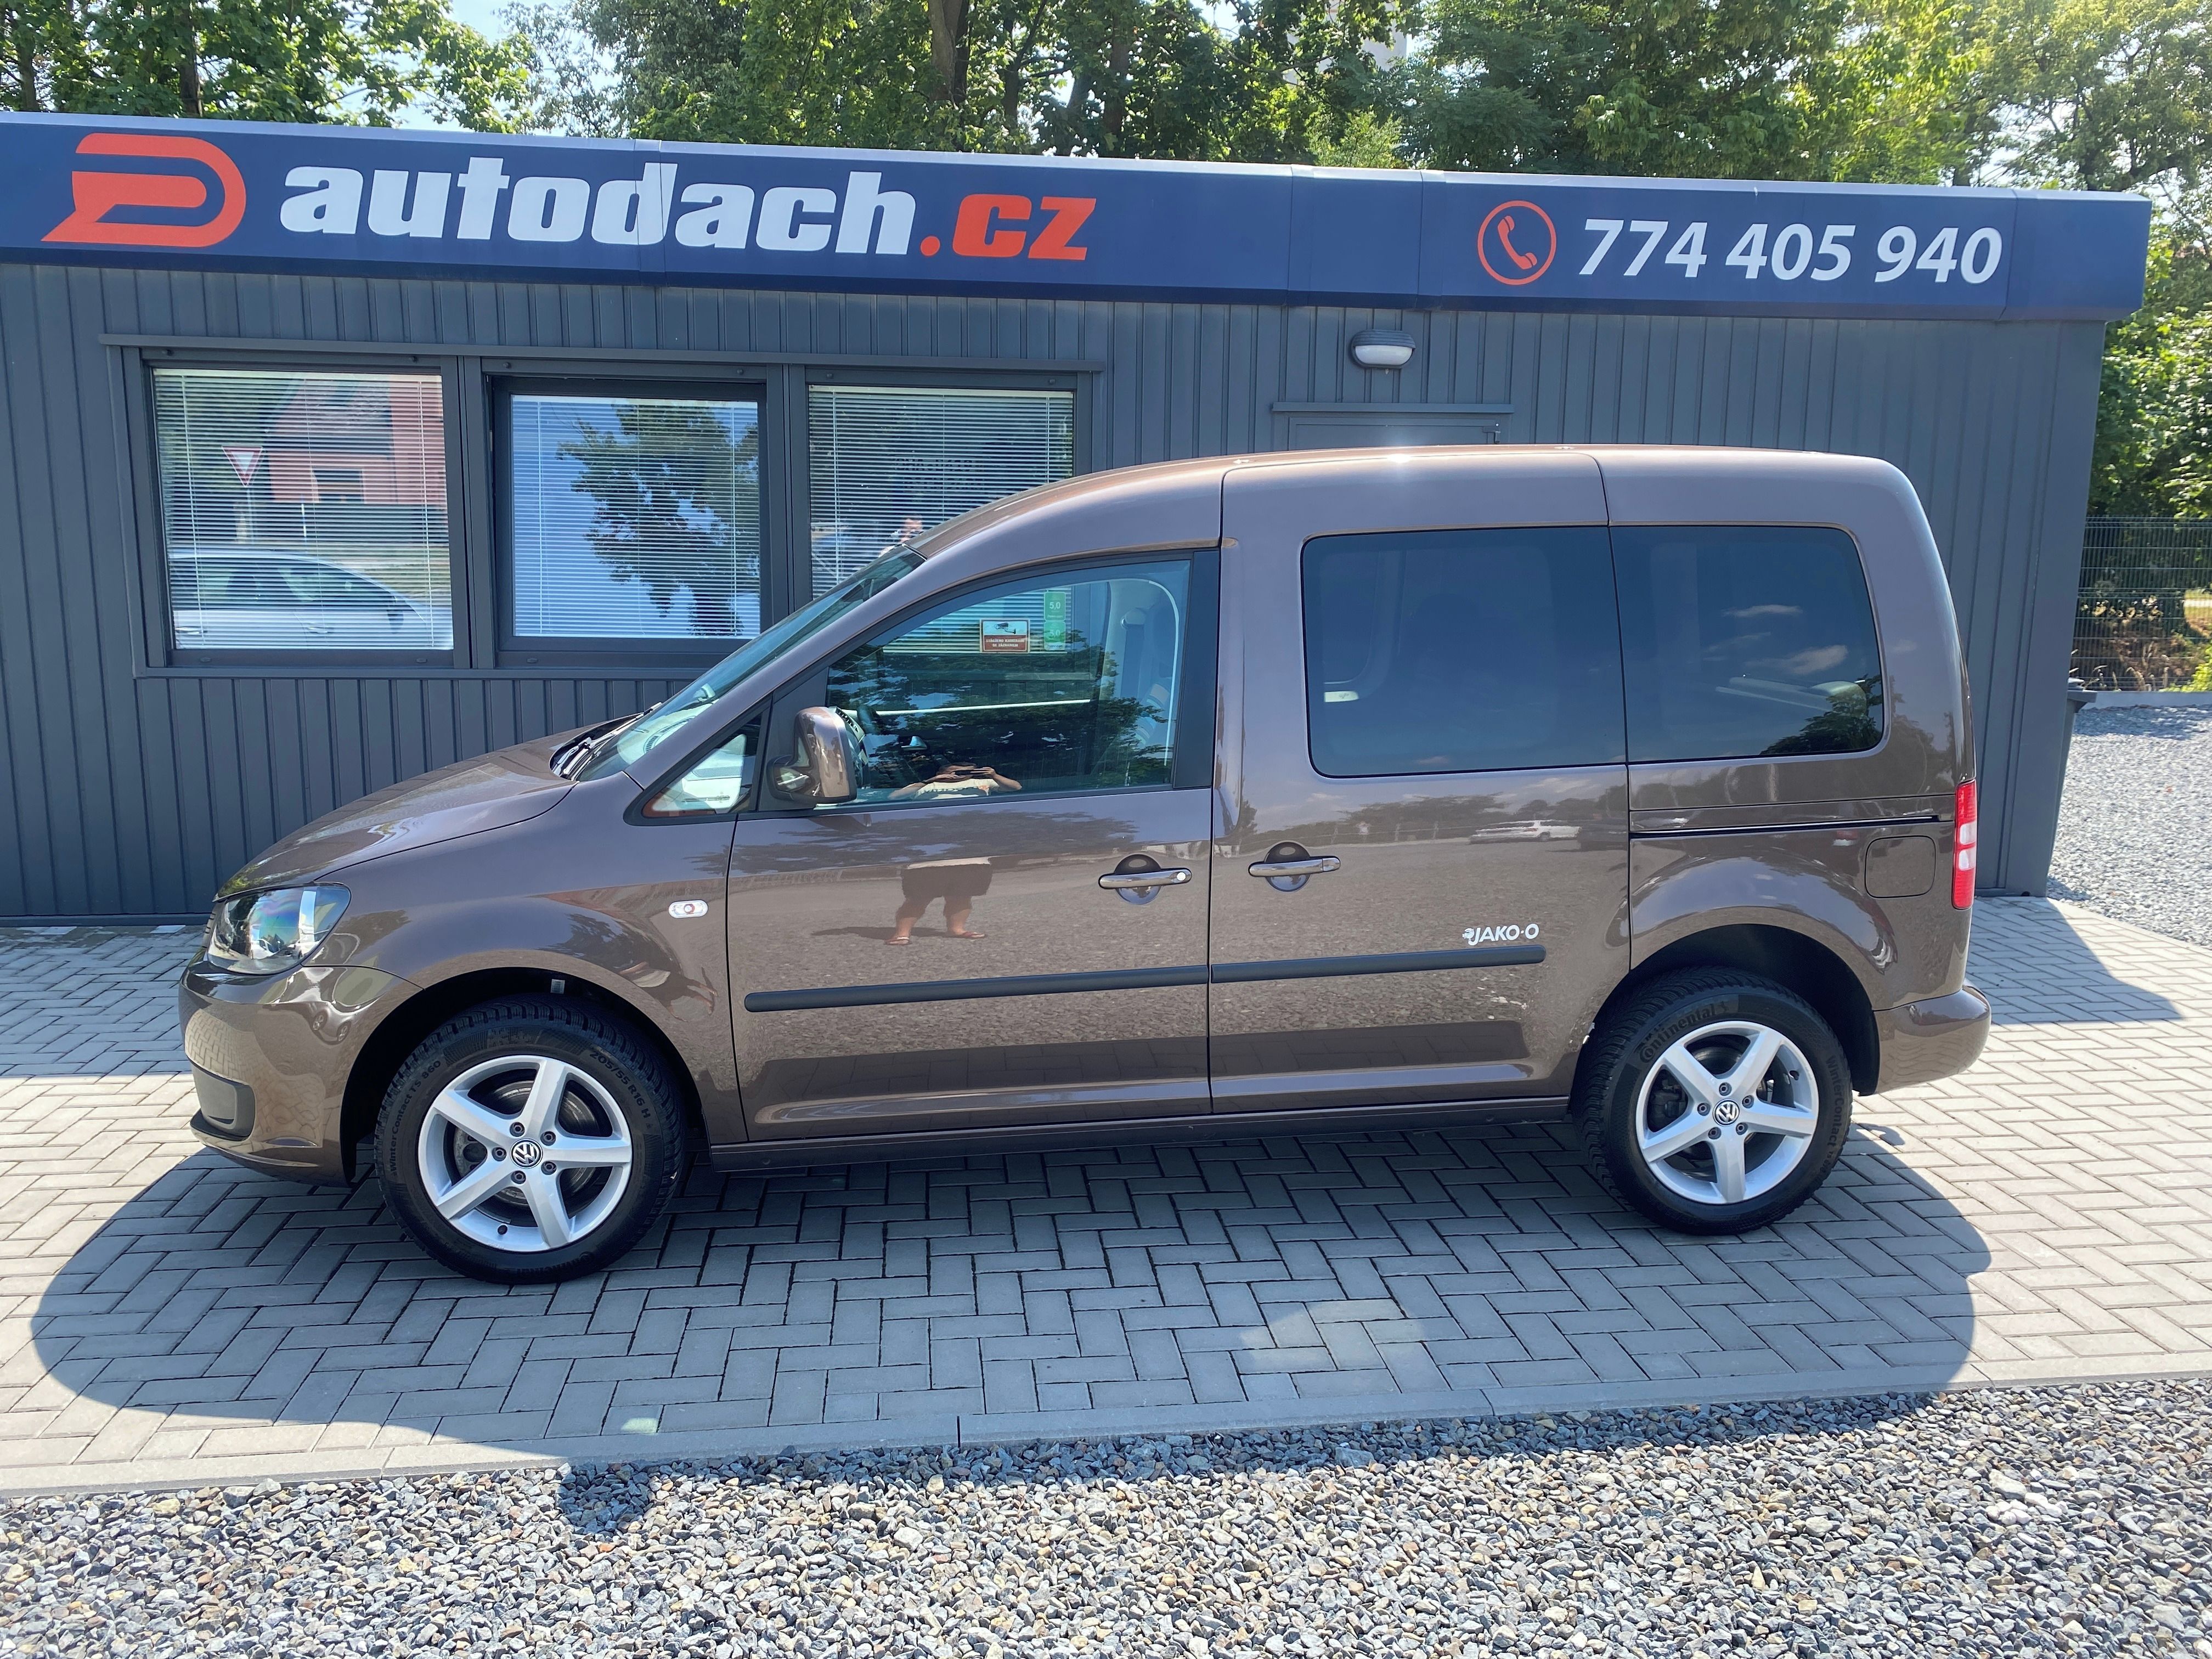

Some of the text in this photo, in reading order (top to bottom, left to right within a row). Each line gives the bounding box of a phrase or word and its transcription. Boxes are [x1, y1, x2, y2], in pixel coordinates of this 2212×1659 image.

[280, 156, 1097, 261] autodach.cz
[1578, 218, 2002, 284] 774 405 940
[1049, 601, 1061, 610] 5,0
[1639, 1003, 1716, 1063] Continental
[409, 1080, 422, 1092] TS
[421, 1060, 441, 1079] 860
[590, 1050, 651, 1118] 205/55 R16 H
